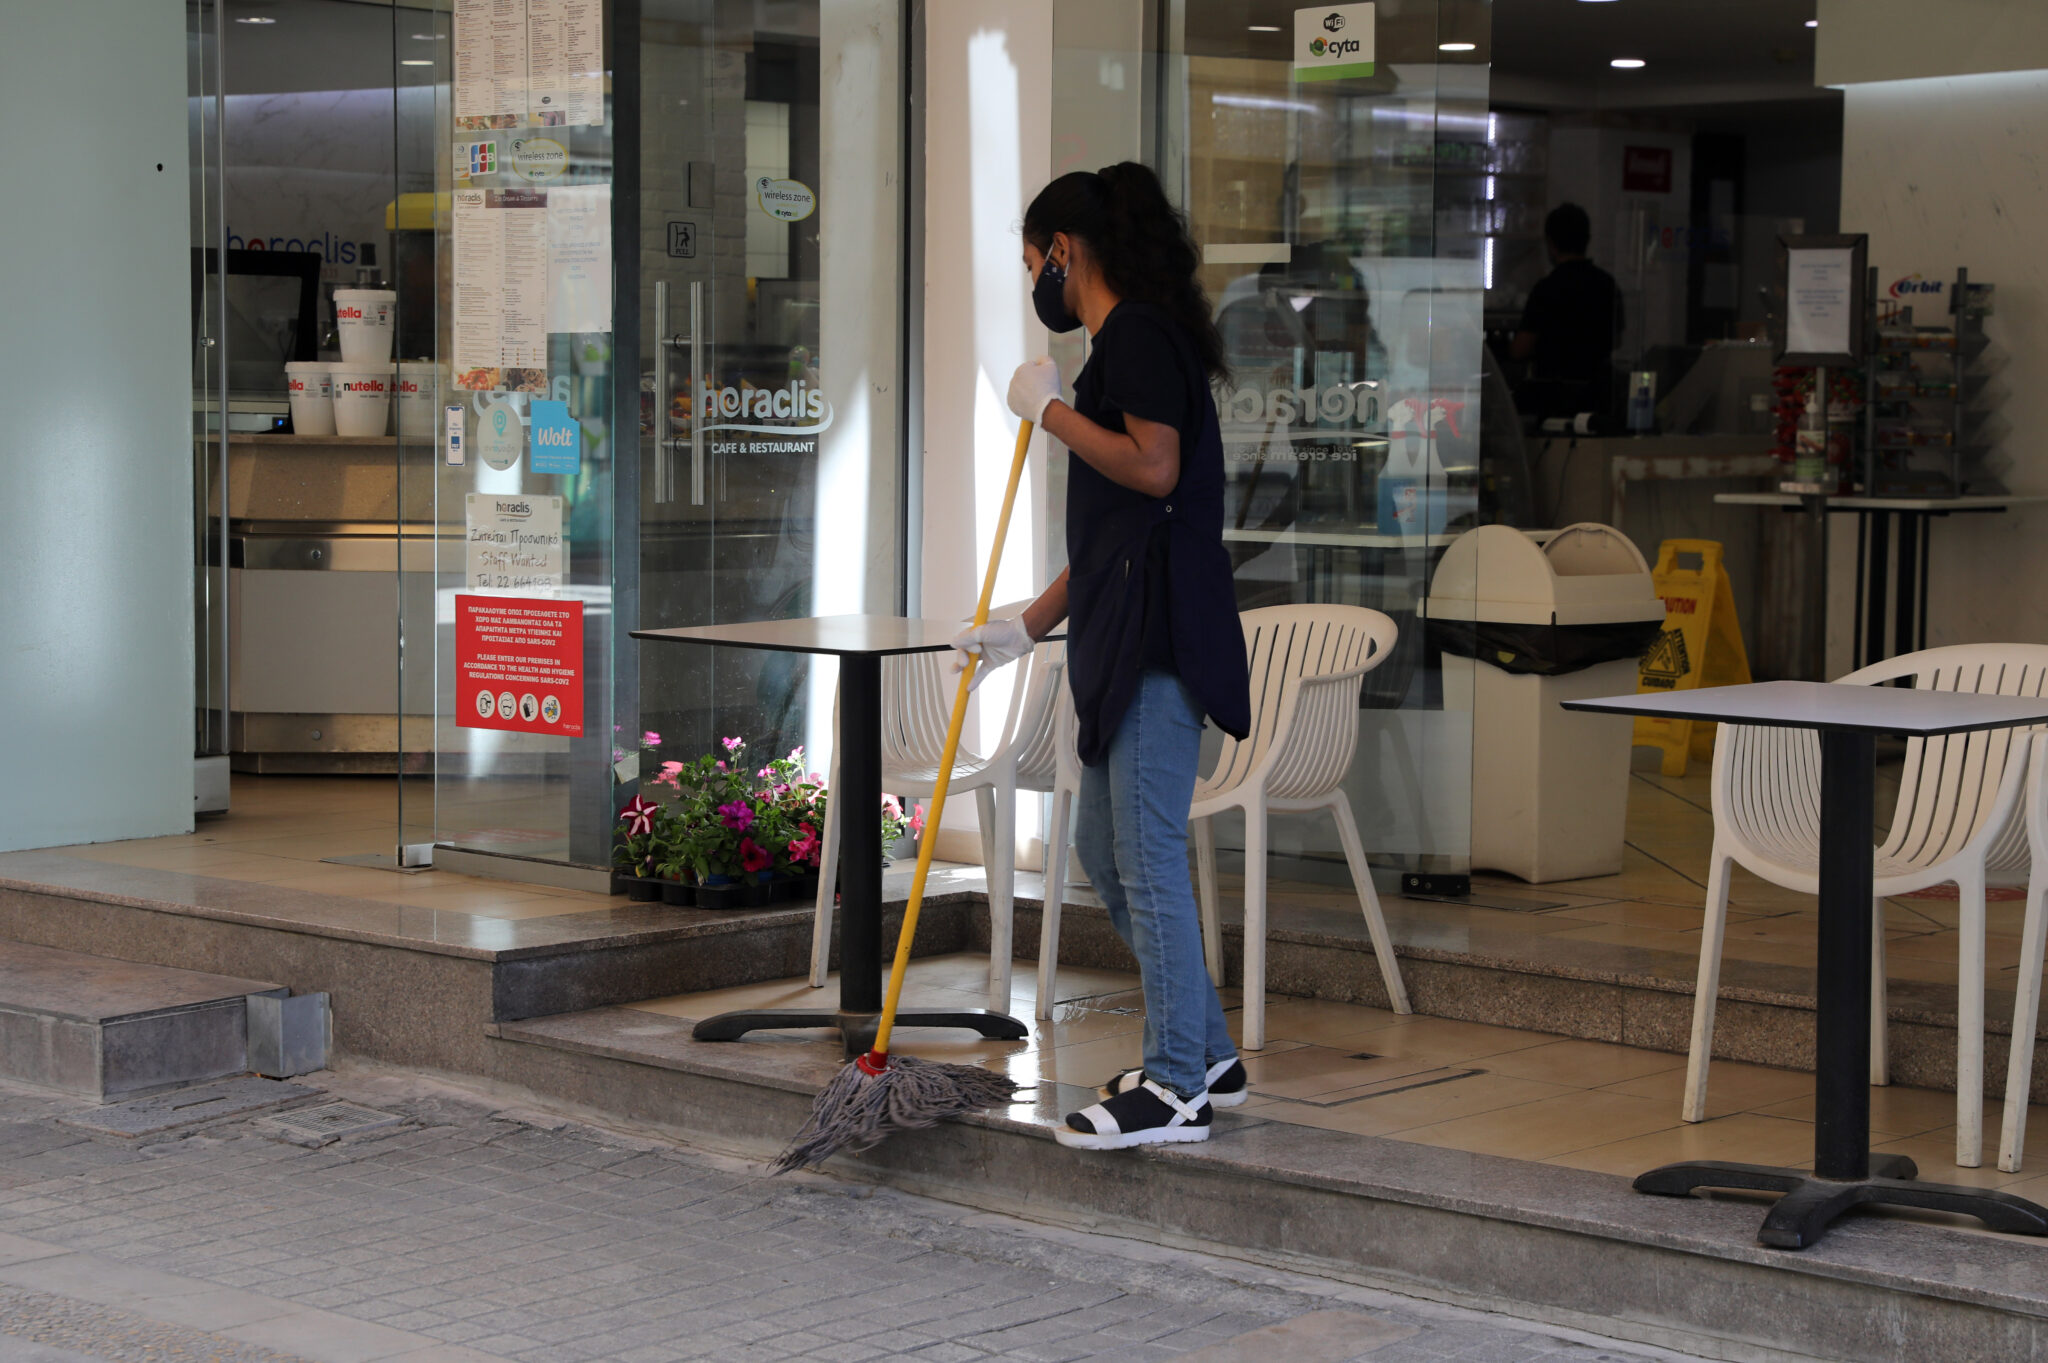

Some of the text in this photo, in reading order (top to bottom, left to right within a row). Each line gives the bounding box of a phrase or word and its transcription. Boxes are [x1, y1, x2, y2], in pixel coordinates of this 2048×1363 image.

[1329, 38, 1360, 58] cyta
[471, 151, 495, 165] JCB
[517, 151, 563, 162] wireless zone
[764, 190, 811, 203] wireless zone
[1897, 280, 1944, 294] Orbit
[343, 380, 384, 392] nutella
[700, 380, 825, 418] heraclis
[537, 427, 574, 447] Wolt
[711, 441, 815, 454] CAFE & RESTAURANT
[496, 501, 530, 513] heraclis
[482, 551, 547, 571] Staff Wanted
[497, 575, 510, 588] 22
[1659, 596, 1697, 615] AUTION
[477, 653, 561, 666] PLEASE ENTER OUR PREMISES IN
[463, 662, 498, 671] ACCORDANCE
[506, 664, 517, 672] THE
[518, 665, 539, 674] HEALTH
[539, 667, 551, 675] AND
[551, 668, 575, 677] HYGIENE
[468, 671, 505, 680] REGULATIONS
[505, 673, 540, 683] CONCERNING
